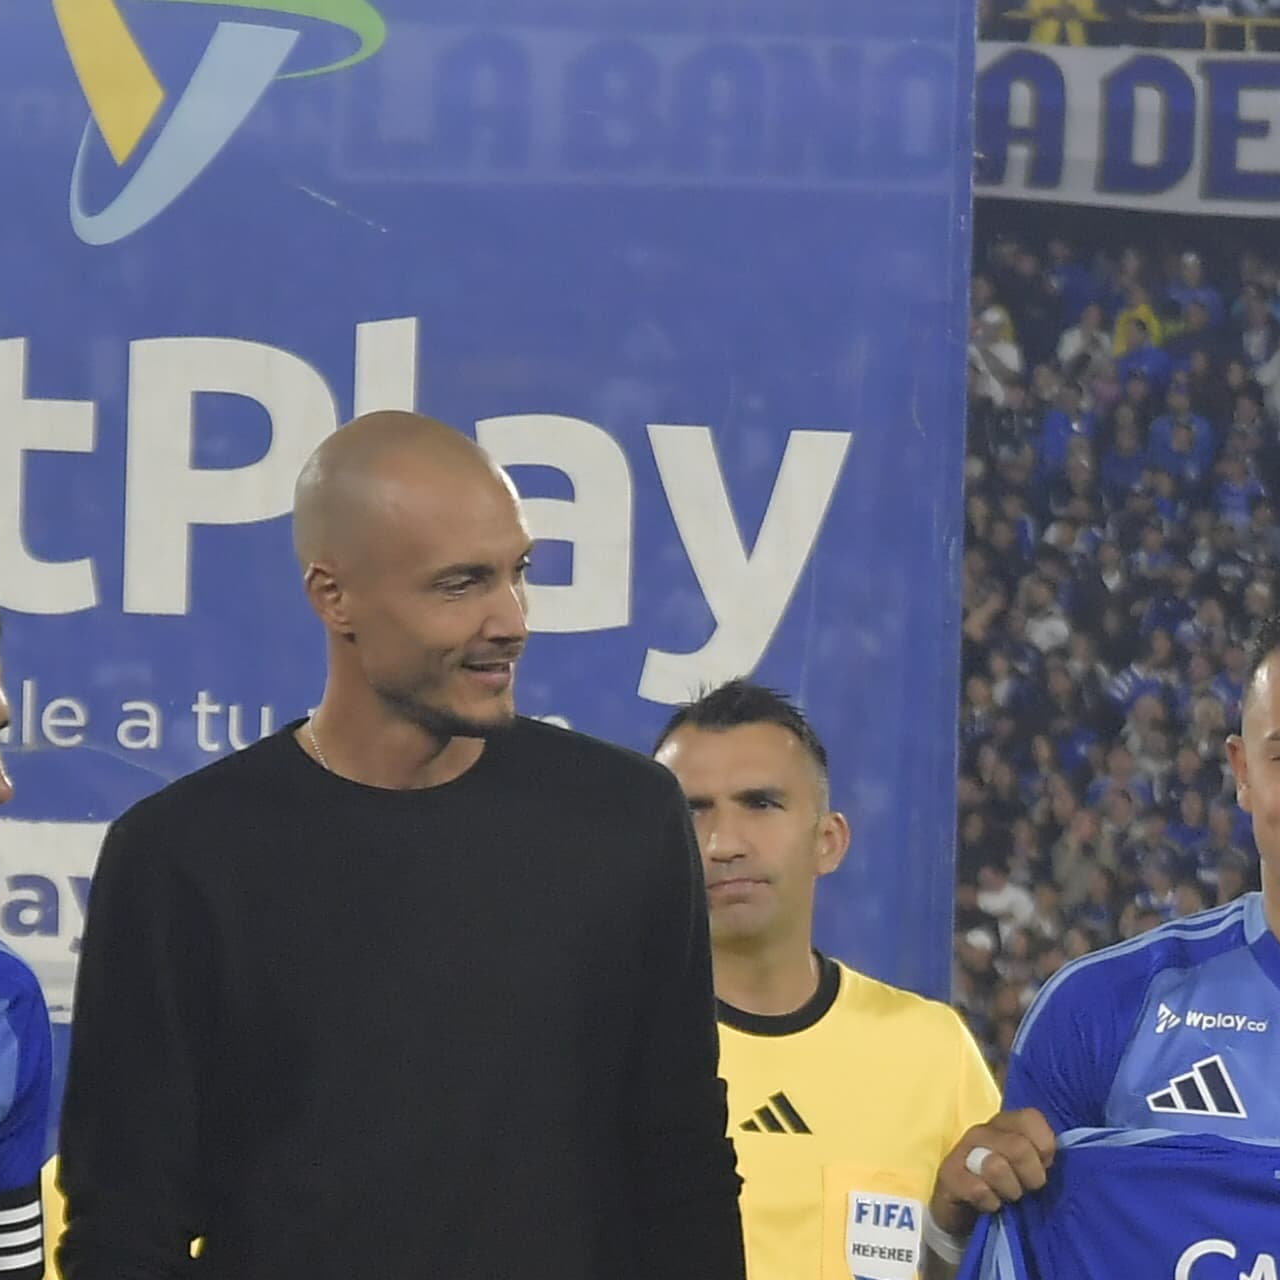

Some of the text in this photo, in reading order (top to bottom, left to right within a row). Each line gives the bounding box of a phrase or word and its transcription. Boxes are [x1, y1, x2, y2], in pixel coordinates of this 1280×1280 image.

[116, 699, 160, 751] a
[192, 690, 273, 751] tu
[1185, 1010, 1267, 1033] Wplay.co
[854, 1201, 915, 1232] FIFA
[852, 1243, 913, 1264] REFEREE
